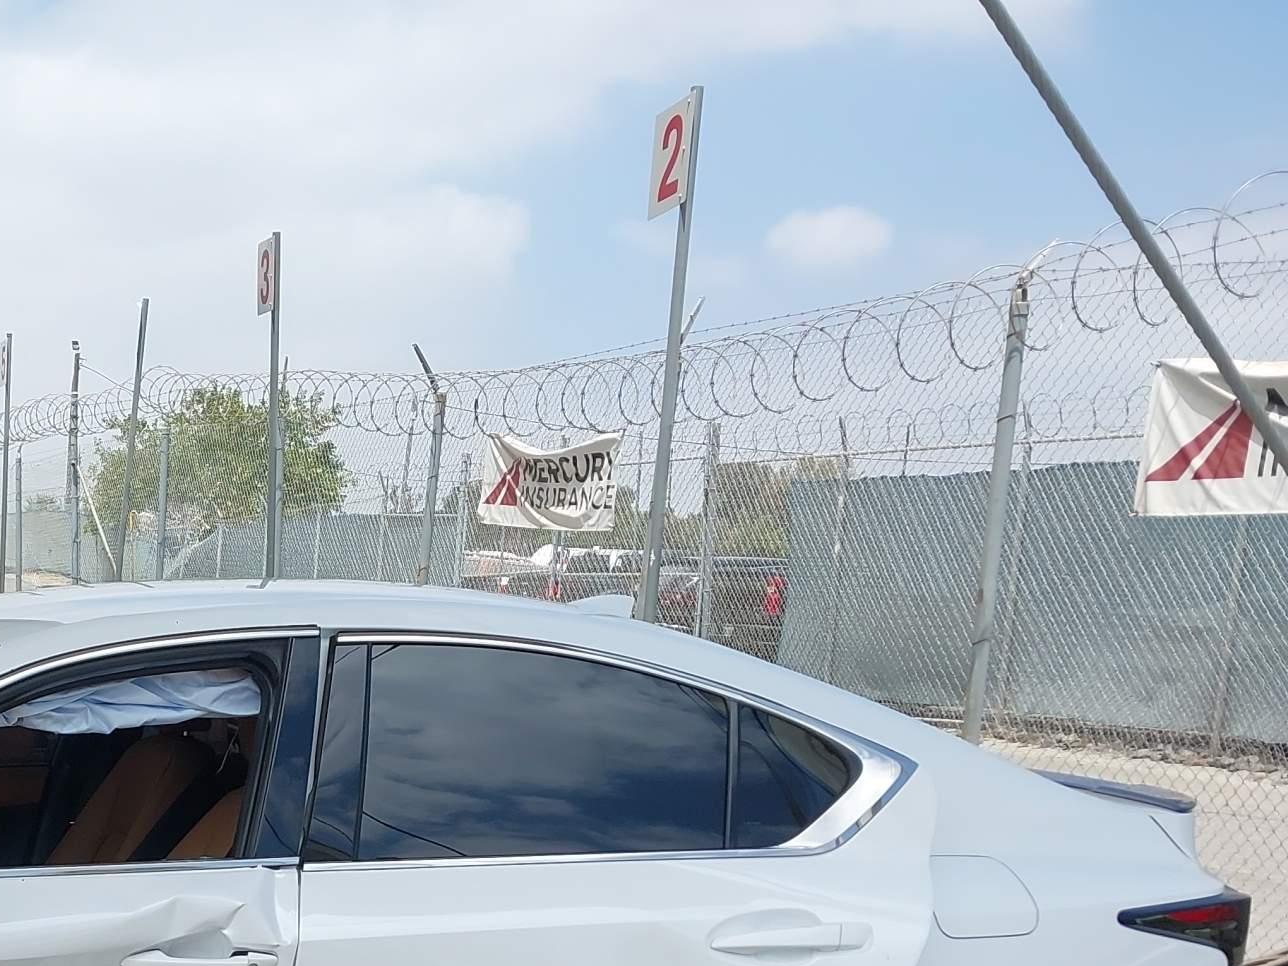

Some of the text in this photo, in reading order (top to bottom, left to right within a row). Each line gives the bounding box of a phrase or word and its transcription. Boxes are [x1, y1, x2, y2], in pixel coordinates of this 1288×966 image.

[657, 114, 684, 203] 2
[260, 249, 270, 305] 3
[522, 452, 613, 483] MERCURY
[521, 485, 615, 510] INSURANCE
